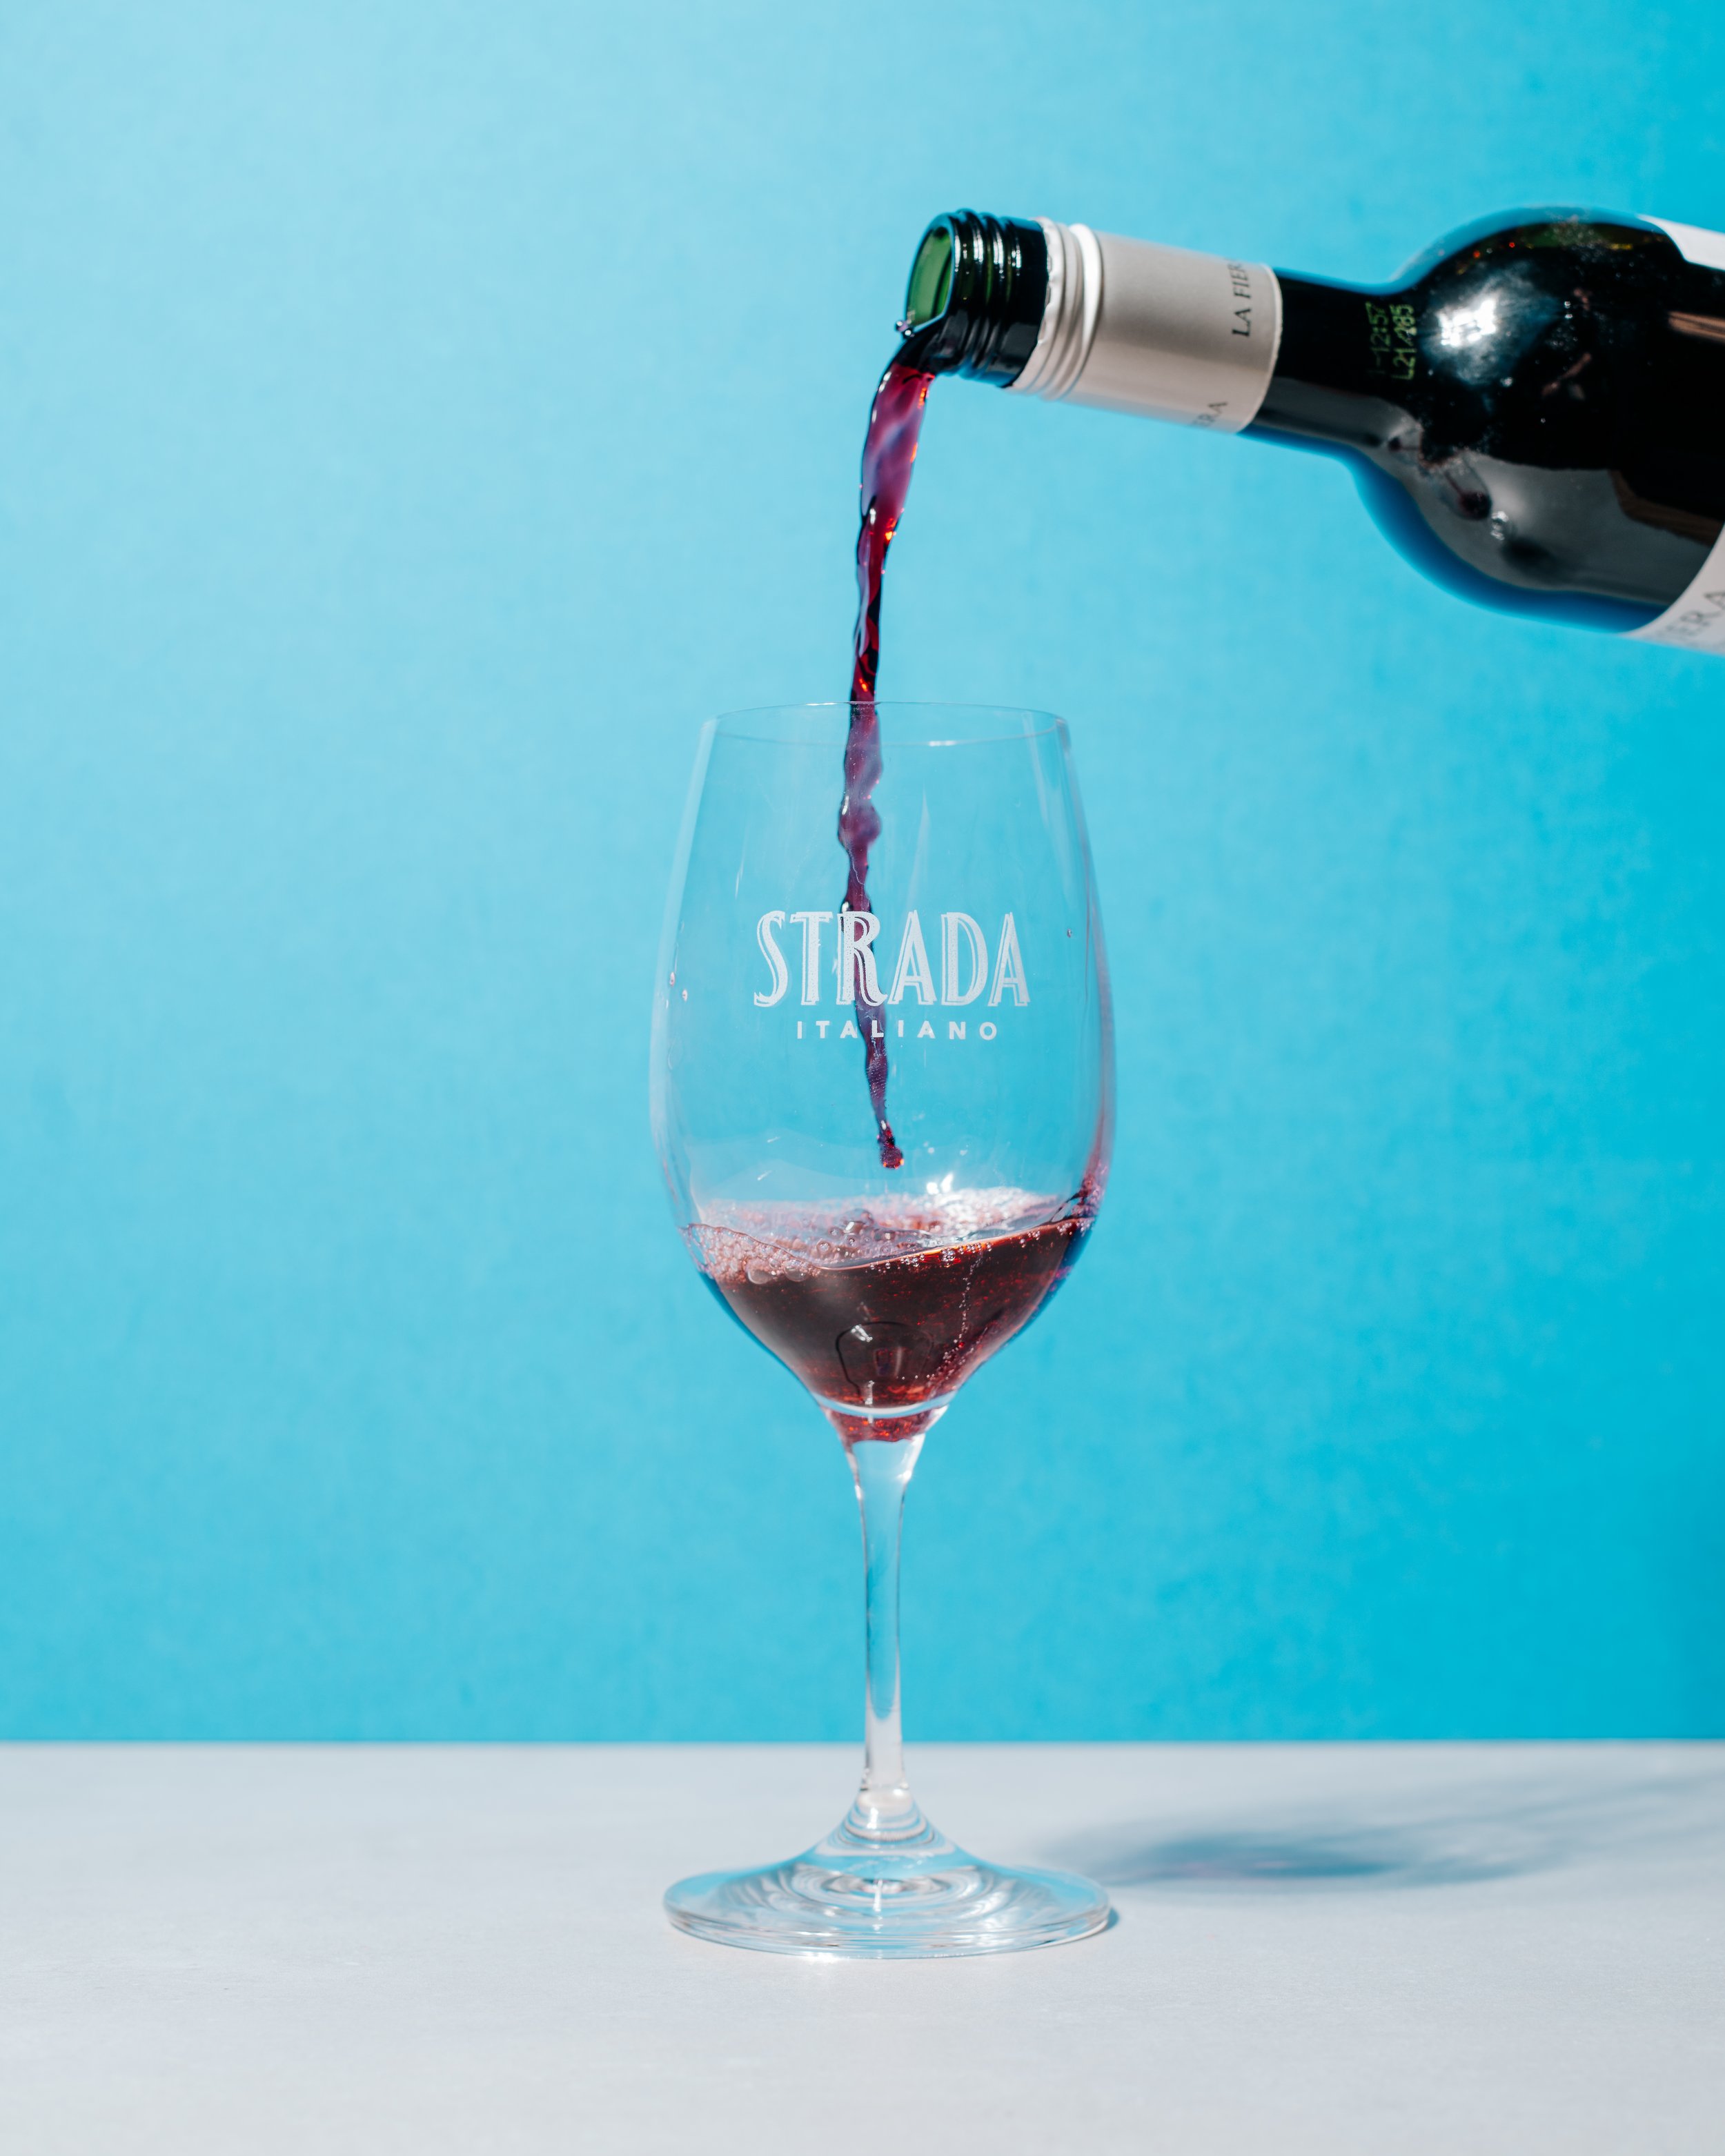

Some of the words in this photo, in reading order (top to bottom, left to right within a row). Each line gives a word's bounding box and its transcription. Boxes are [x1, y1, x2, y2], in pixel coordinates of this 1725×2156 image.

[1227, 262, 1252, 299] FIER
[1231, 308, 1252, 337] LA
[753, 909, 1030, 1007] STRADA
[797, 1020, 997, 1040] ITALIANO
